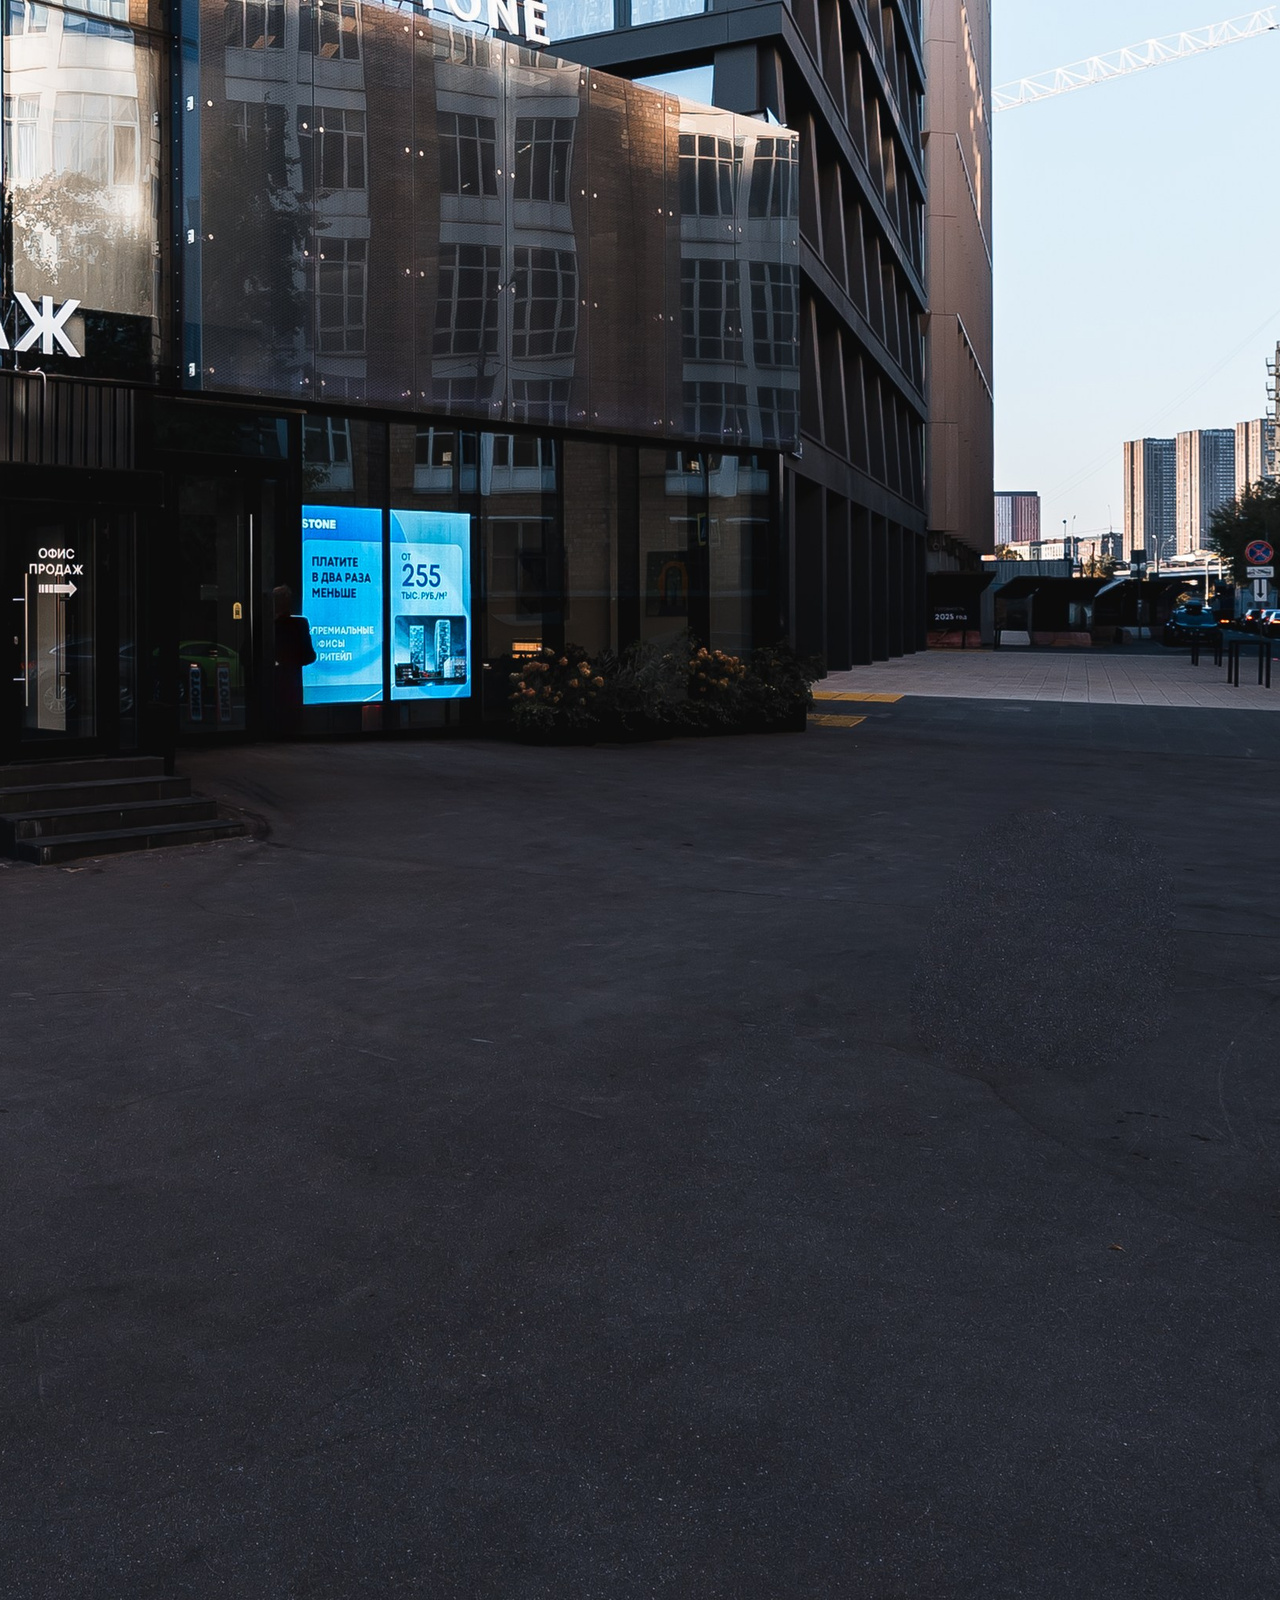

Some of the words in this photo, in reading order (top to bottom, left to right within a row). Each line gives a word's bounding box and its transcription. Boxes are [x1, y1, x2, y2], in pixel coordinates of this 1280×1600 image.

[302, 517, 337, 530] STONE
[38, 547, 75, 560] ОФИС
[401, 552, 412, 561] ОТ
[312, 556, 359, 568] ПЛАТИТЕ
[29, 562, 84, 577] ПРОДАЖ
[402, 563, 441, 588] 255
[312, 572, 319, 582] В
[321, 572, 343, 584] ДВА
[345, 572, 372, 583] РАЗА
[312, 587, 357, 598] МЕНЬШЕ
[316, 639, 345, 648] ФИСЫ
[320, 650, 353, 661] РИТЕЙЛ
